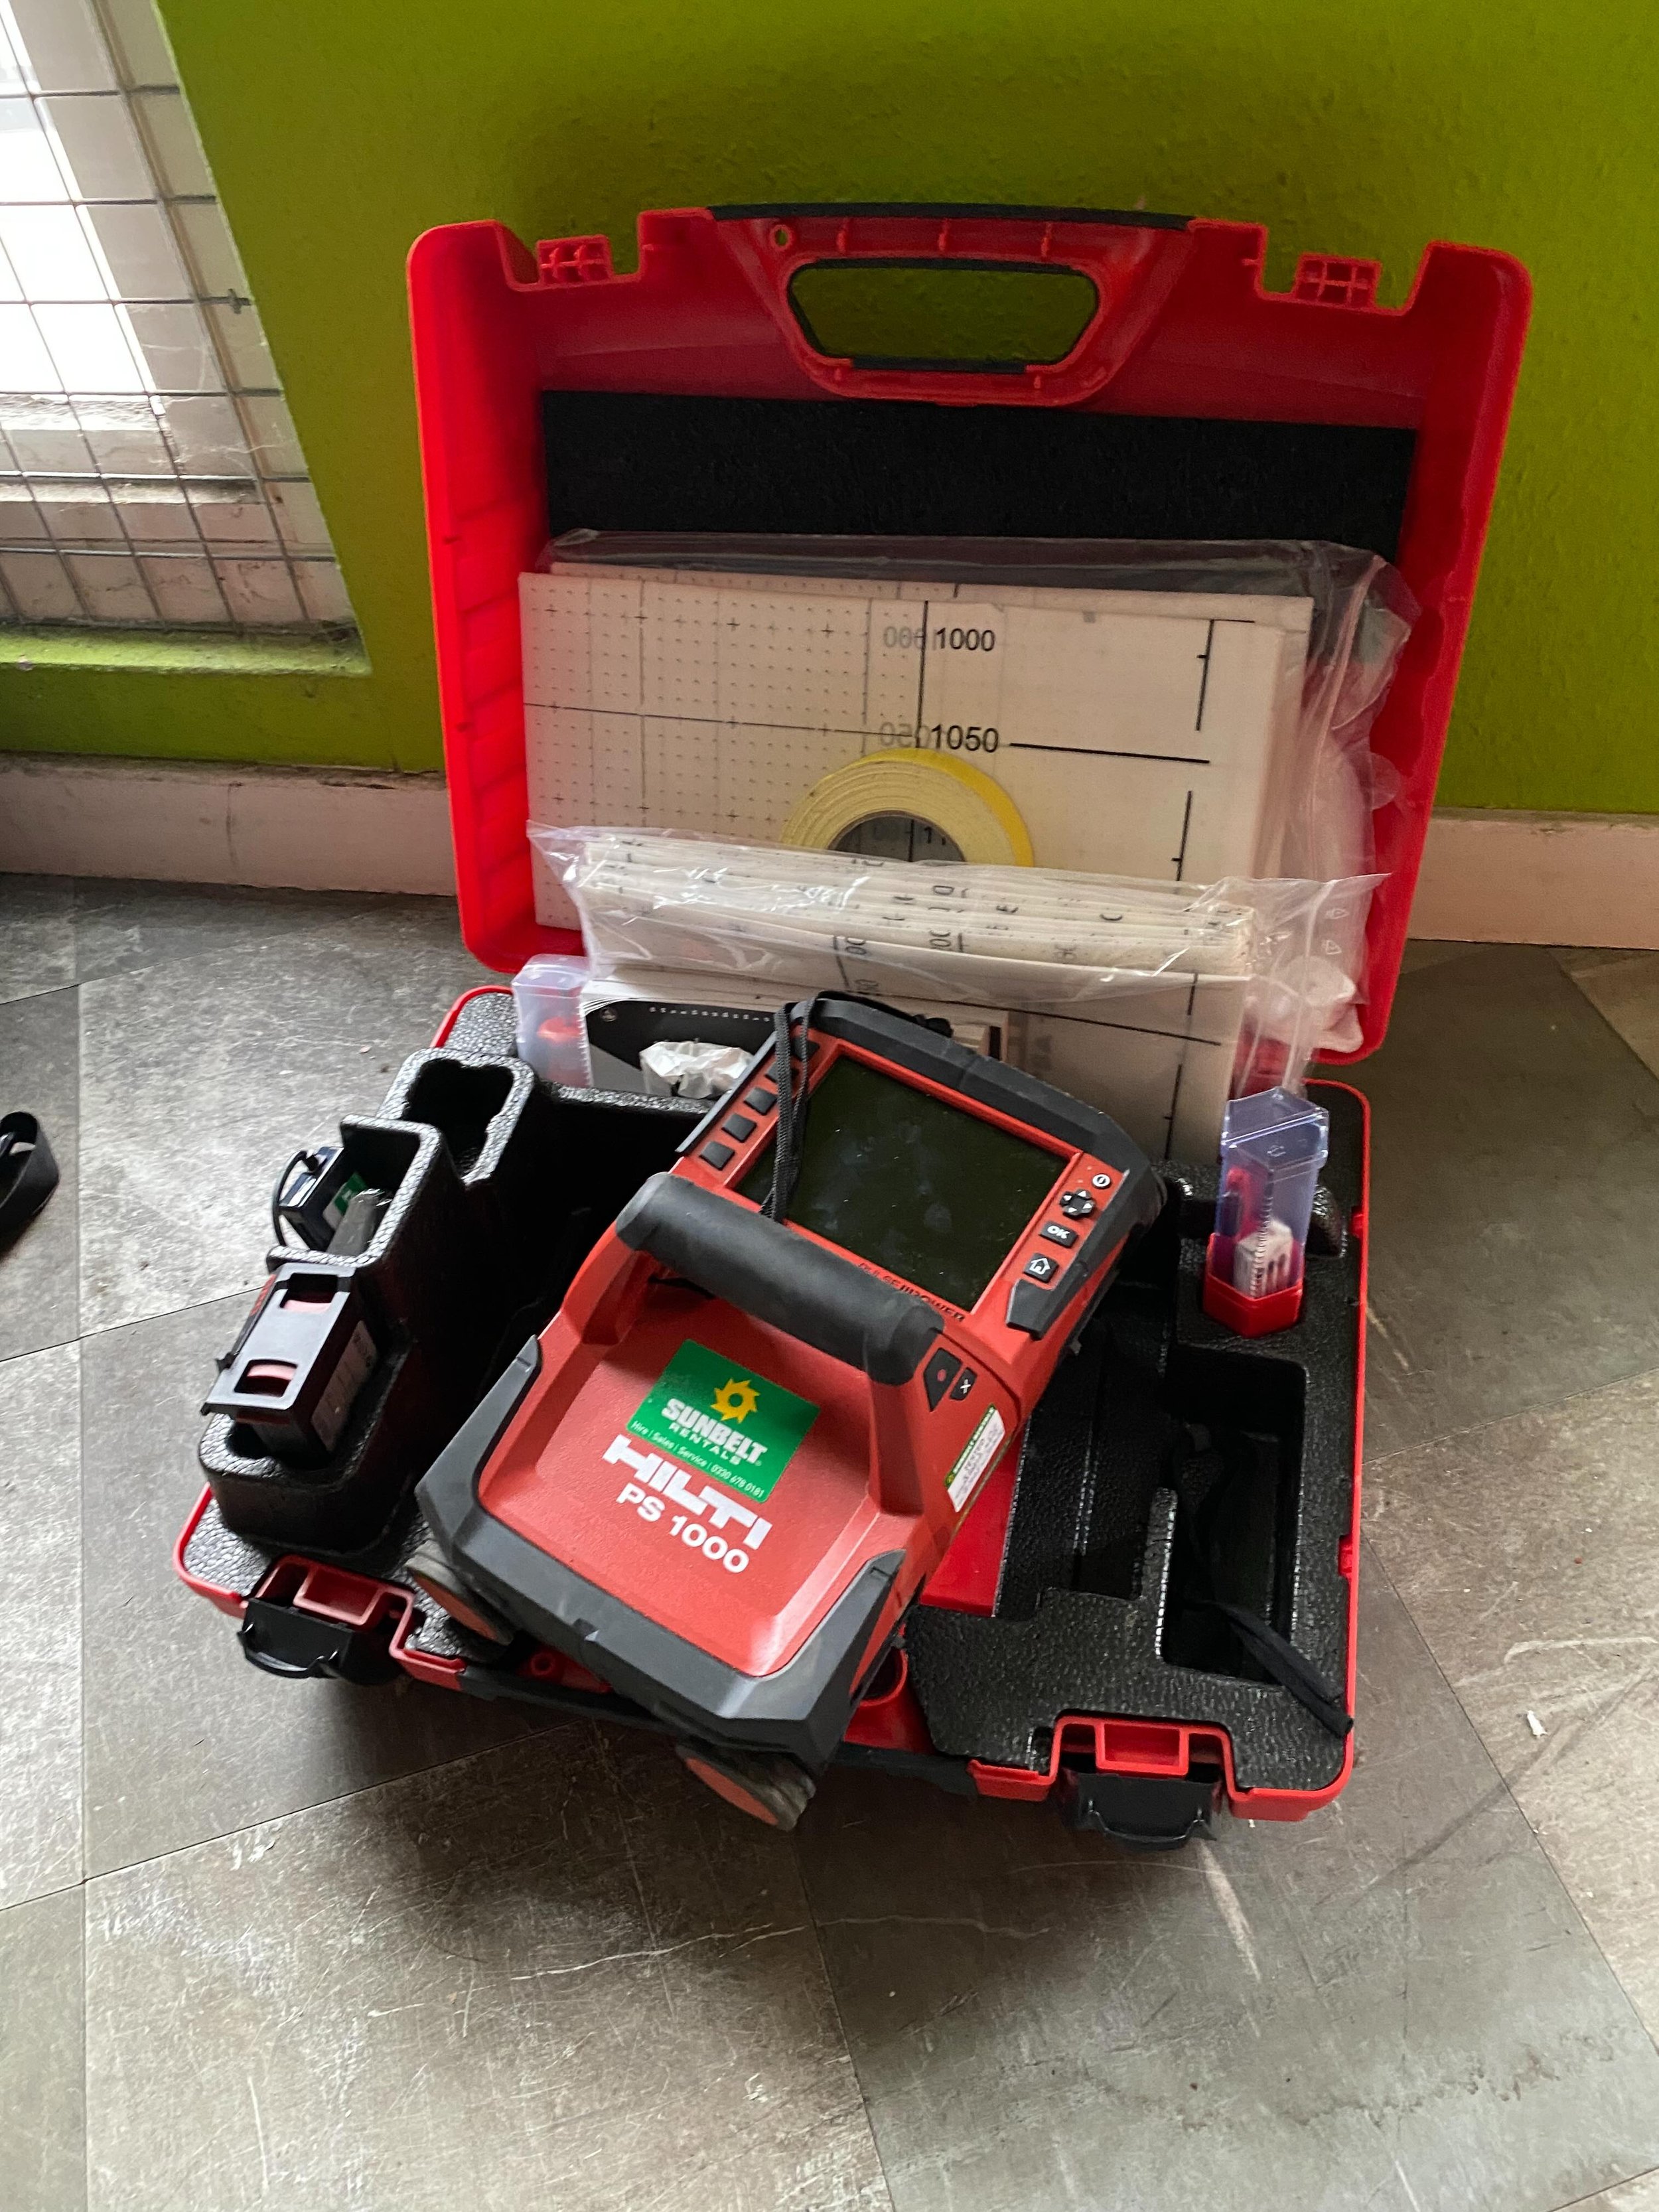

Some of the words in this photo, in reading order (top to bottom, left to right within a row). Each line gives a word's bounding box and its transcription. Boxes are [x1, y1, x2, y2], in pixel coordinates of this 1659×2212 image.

[936, 627, 995, 652] 1000
[931, 724, 999, 753] 1050
[1046, 1224, 1070, 1240] OK
[630, 1421, 648, 1436] Hire
[652, 1431, 674, 1449] Sales
[677, 1445, 708, 1467] Service
[662, 1398, 768, 1463] SUNBELT
[669, 1422, 741, 1465] RENTALS
[602, 1434, 773, 1550] HILTI
[616, 1483, 666, 1522] PS
[669, 1515, 750, 1574] 1000
